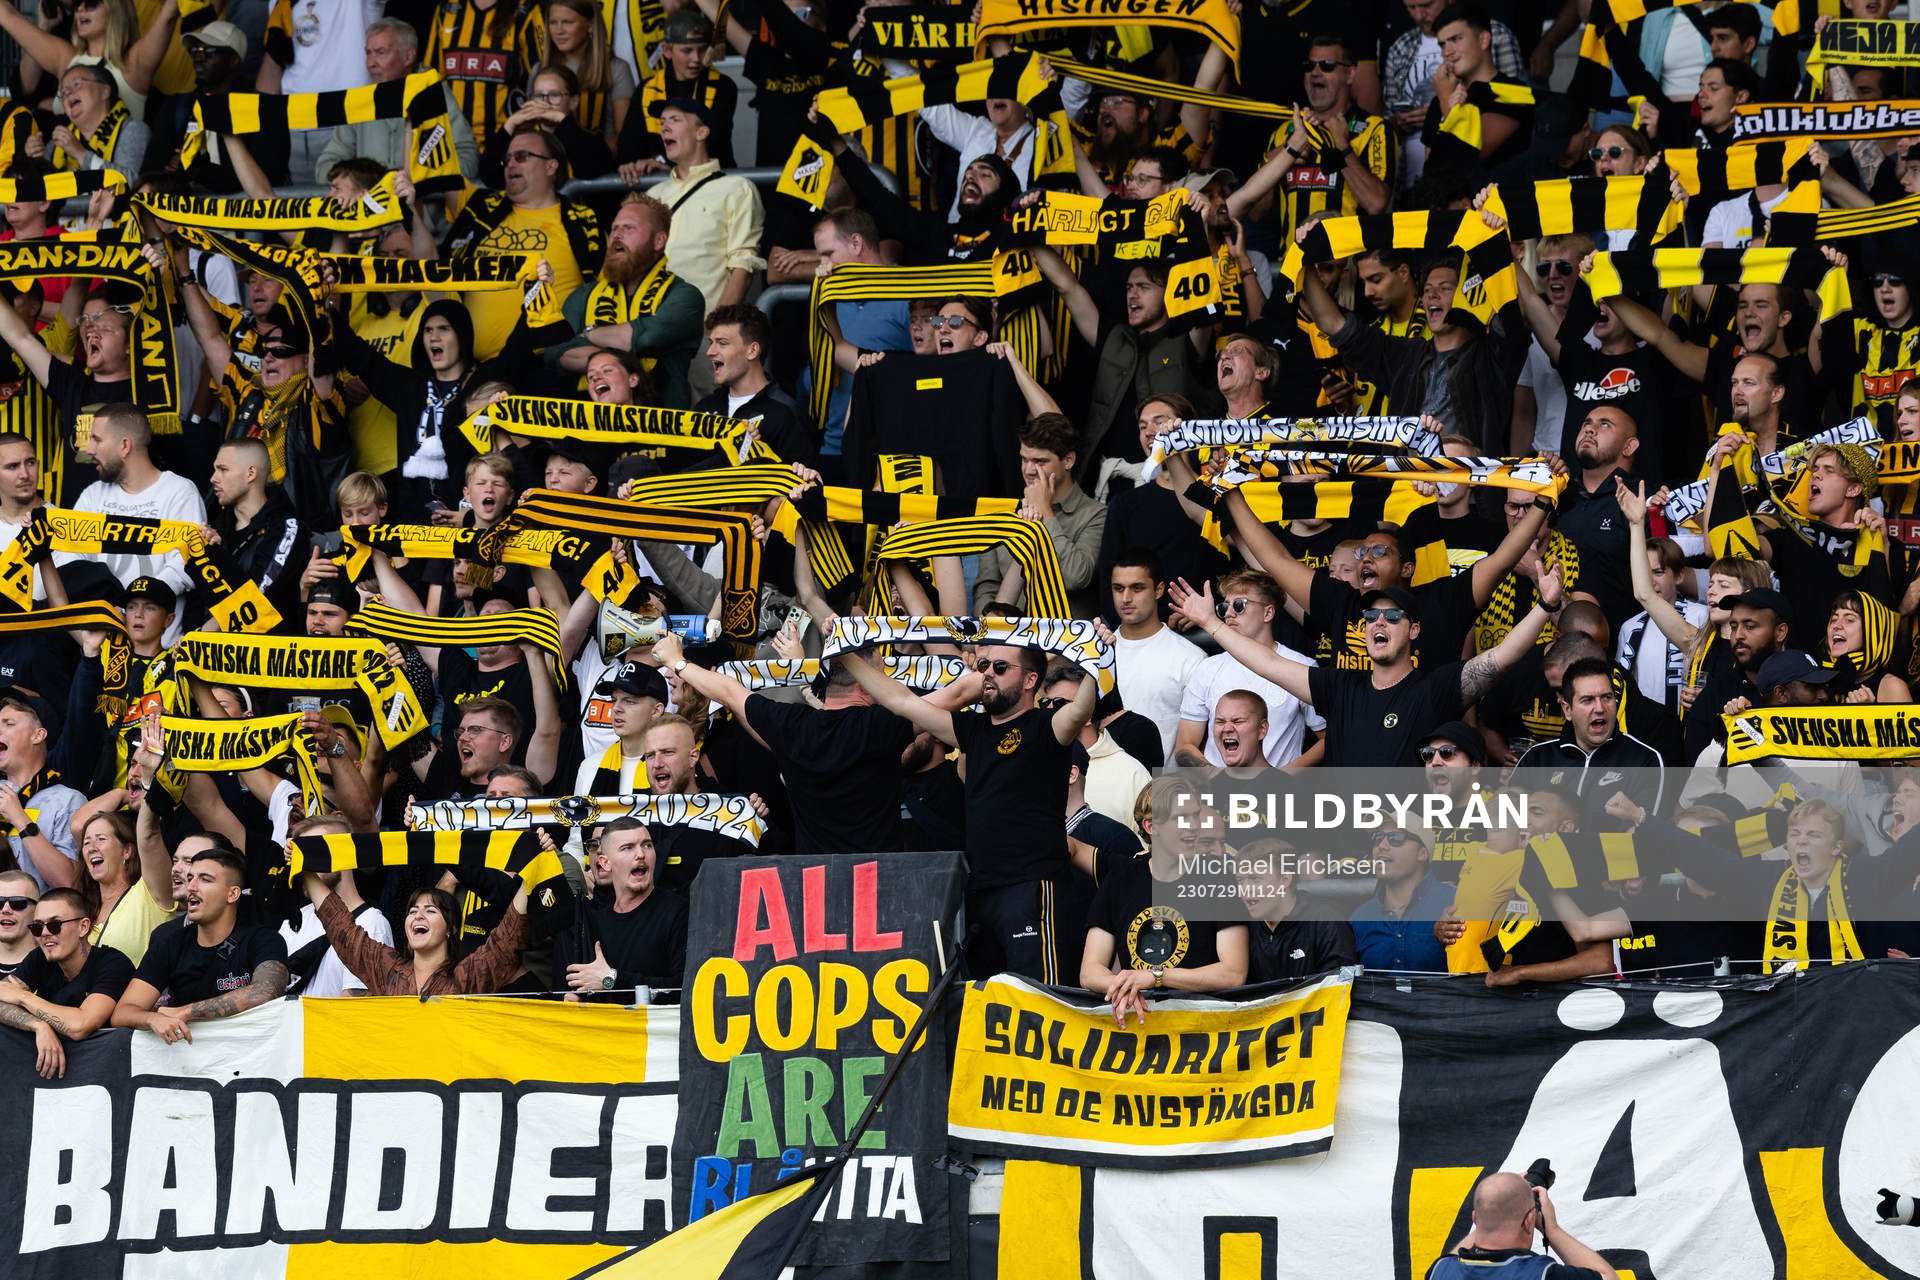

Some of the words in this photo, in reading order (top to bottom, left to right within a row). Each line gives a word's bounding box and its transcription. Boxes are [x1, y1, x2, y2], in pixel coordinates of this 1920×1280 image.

[873, 21, 903, 47] VI
[909, 15, 949, 48] ÄR
[446, 57, 503, 71] BRA
[1012, 201, 1136, 234] HÄRLIGT
[1002, 252, 1033, 277] 40
[1173, 273, 1211, 300] 40
[495, 398, 586, 430] SVENSKA
[1267, 417, 1291, 443] G
[227, 600, 258, 633] 40
[175, 639, 262, 676] SVENSKA
[266, 643, 357, 679] MÄSTARE
[823, 615, 928, 658] 2012
[1006, 615, 1115, 669] 2022
[1770, 715, 1872, 747] SVENSKA
[412, 797, 532, 830] 2012
[621, 793, 756, 840] 2022
[733, 862, 903, 962] ALL
[692, 957, 931, 1063] COPS
[985, 1003, 1326, 1076] SOLIDARITET
[715, 1053, 888, 1160] ARE
[981, 1074, 1045, 1114] MED
[1056, 1088, 1101, 1123] DE
[1112, 1079, 1316, 1128] AVSTÄNGDA
[19, 1086, 679, 1254] BANDIER
